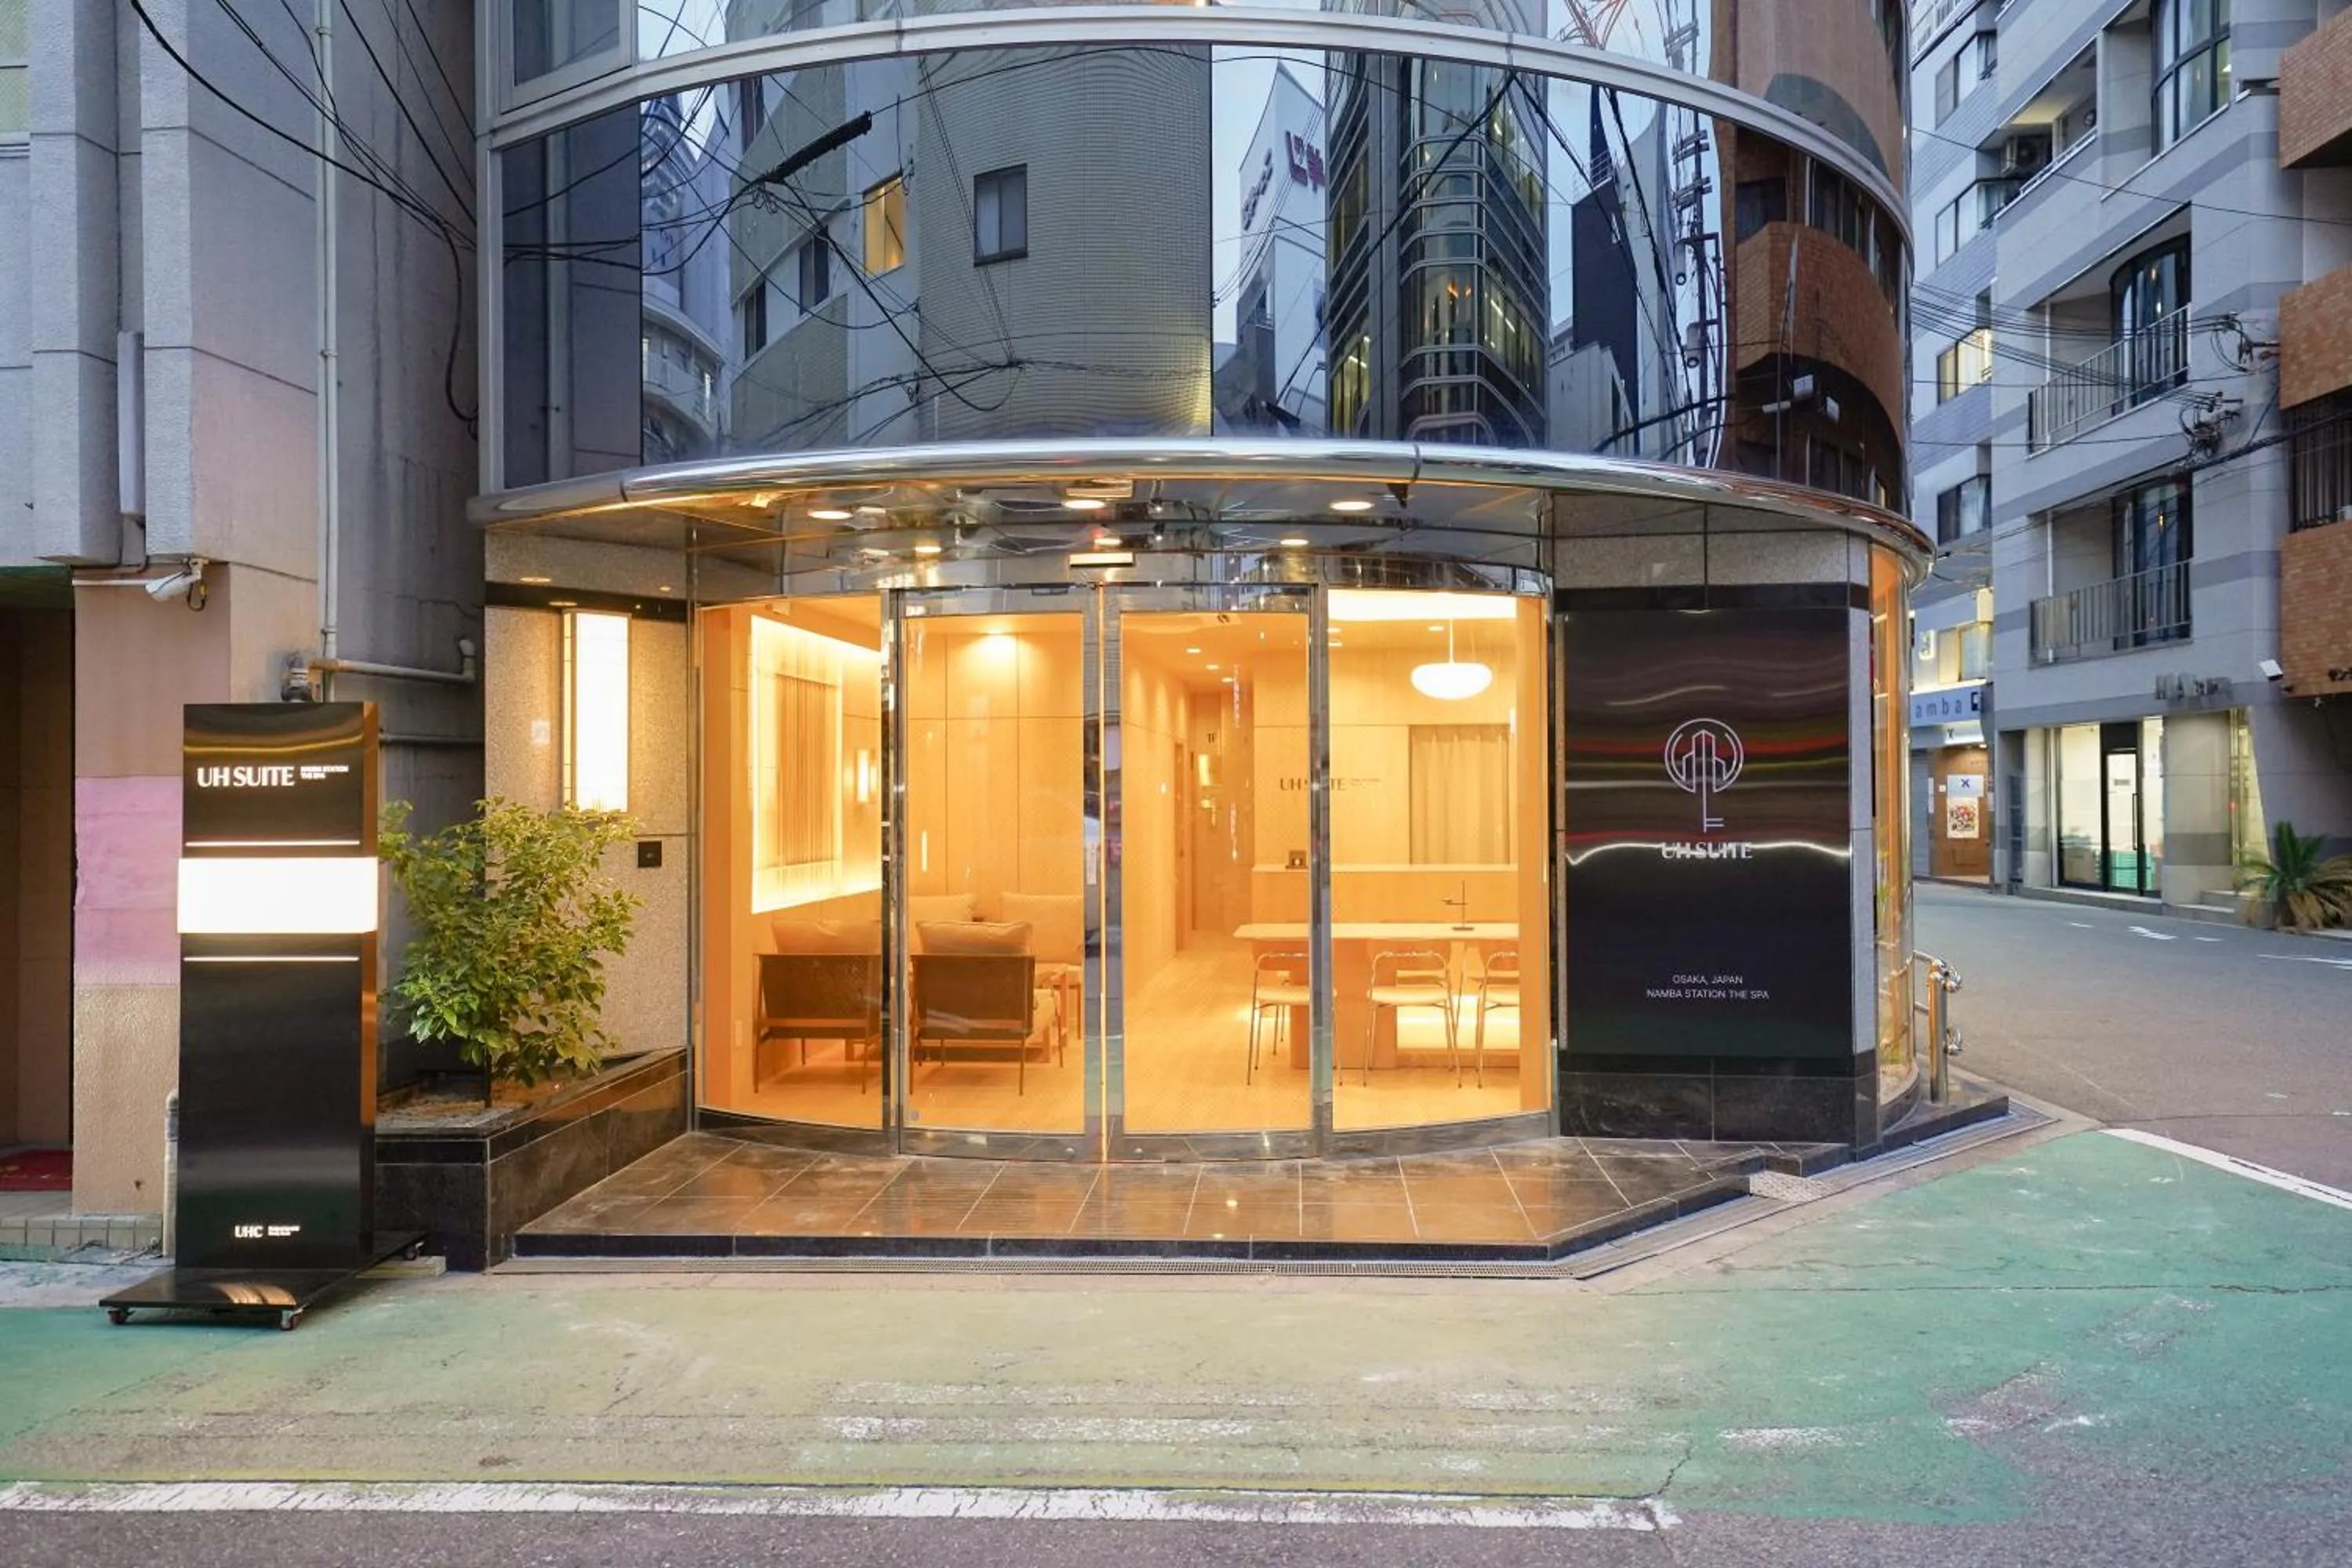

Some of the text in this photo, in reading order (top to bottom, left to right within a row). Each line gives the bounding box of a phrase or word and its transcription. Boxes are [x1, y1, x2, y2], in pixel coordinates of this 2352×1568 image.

[197, 765, 296, 788] UH SUITE
[1661, 841, 1754, 859] UH SUITE
[1671, 975, 1744, 985] OSAKA, JAPAN
[1646, 988, 1769, 1000] NAMBA STATION THE SPA
[234, 1225, 263, 1239] UHC
